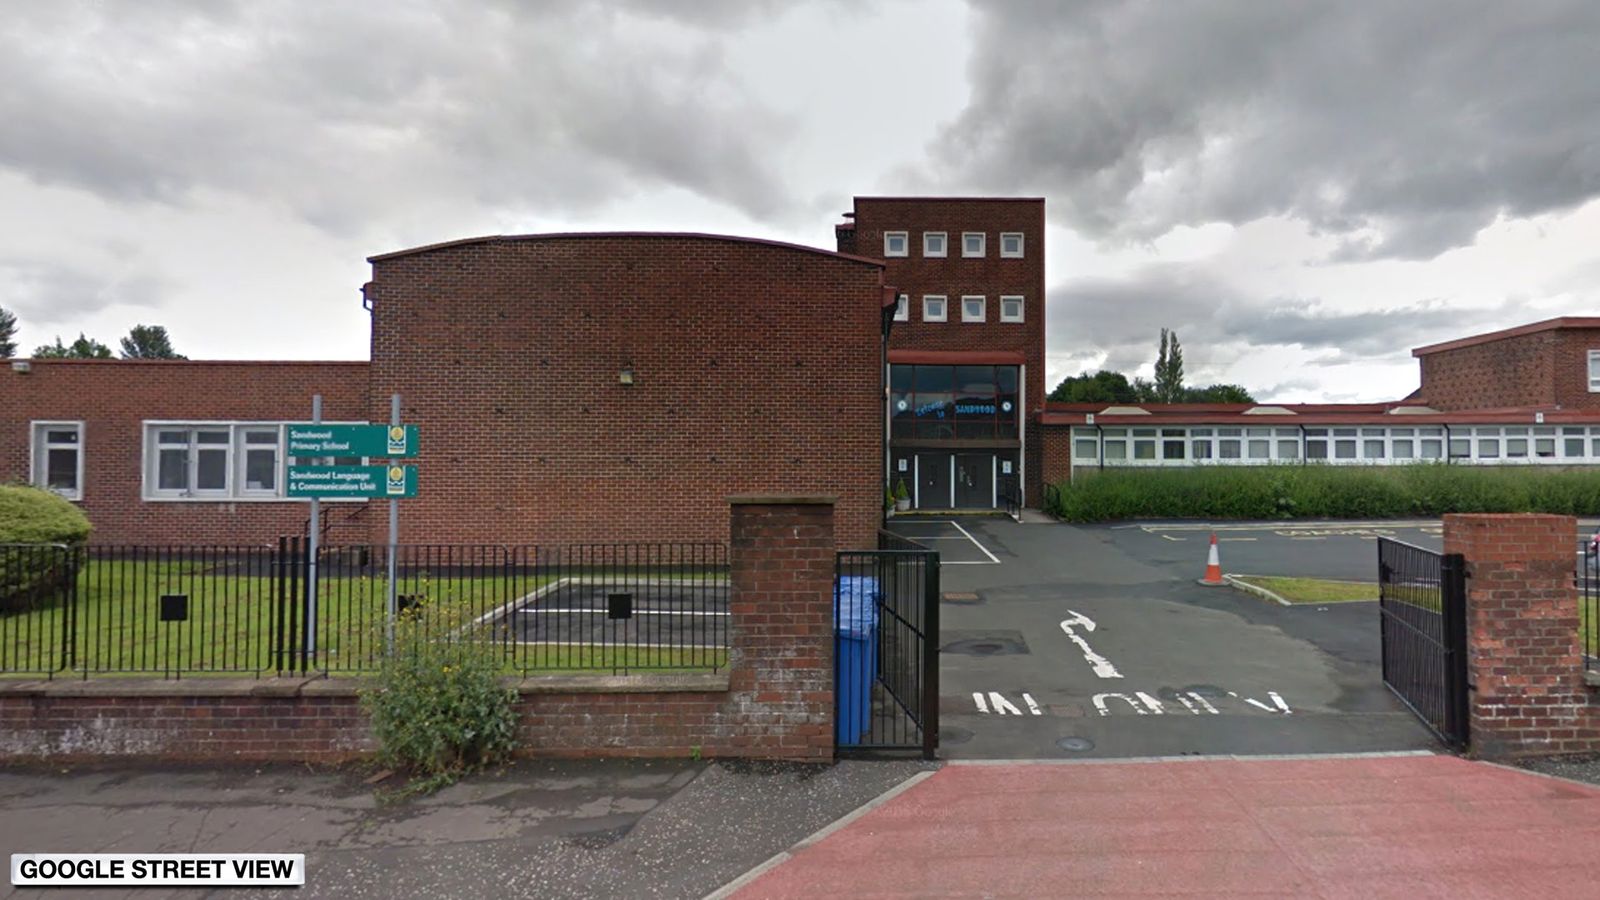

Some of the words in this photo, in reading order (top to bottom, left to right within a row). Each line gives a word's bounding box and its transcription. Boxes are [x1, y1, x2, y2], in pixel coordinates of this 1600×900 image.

[291, 430, 332, 439] Sandwood
[291, 441, 321, 451] Primary
[322, 441, 350, 450] School
[290, 471, 330, 479] Sandwood
[332, 471, 370, 481] Language
[289, 482, 297, 491] &
[298, 482, 358, 491] Communication
[360, 482, 376, 491] Unit
[972, 692, 1042, 715] IN
